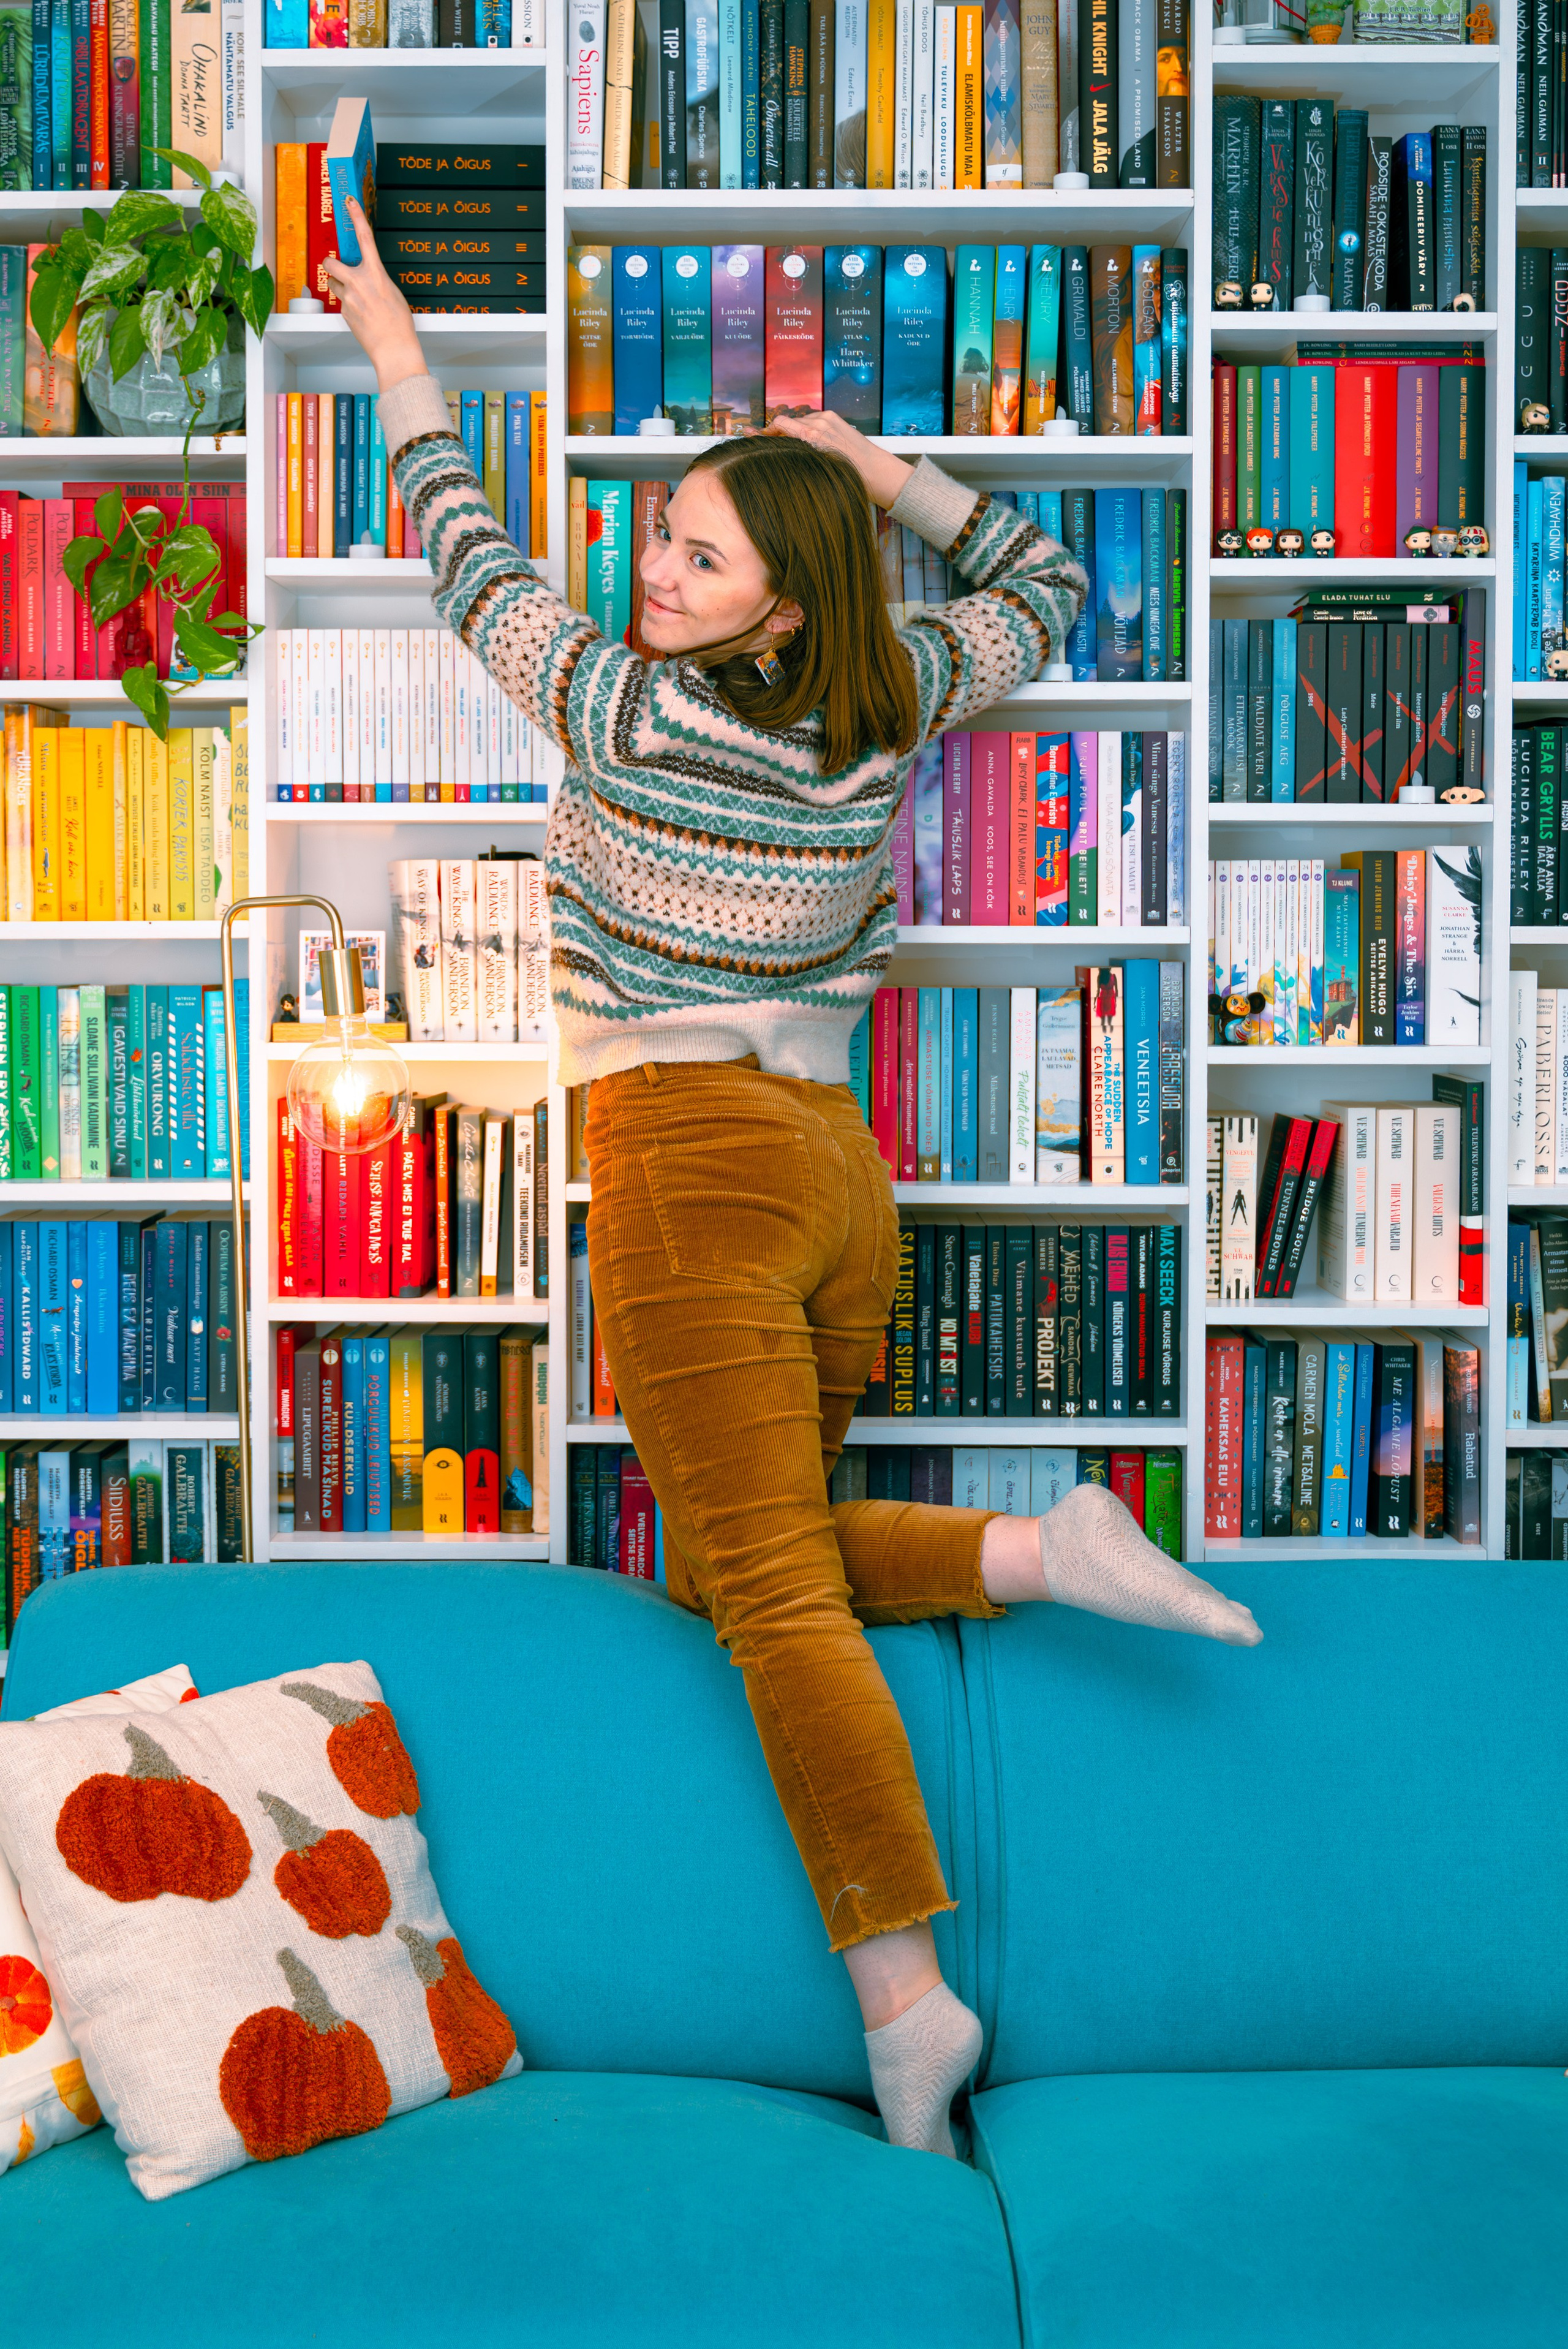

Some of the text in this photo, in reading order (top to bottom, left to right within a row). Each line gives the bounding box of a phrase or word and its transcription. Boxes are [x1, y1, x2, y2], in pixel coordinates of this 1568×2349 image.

[1027, 15, 1052, 25] JOHN
[1028, 26, 1050, 36] GUY
[663, 28, 679, 59] TIPP
[696, 17, 707, 92] GASTROFÜÜSIKA
[1092, 21, 1106, 75] KNIGHT
[572, 48, 599, 134] Sapiens
[746, 93, 755, 157] TÄHELOOD
[1093, 99, 1111, 173] JALA JÄLG
[399, 156, 491, 171] TÕDE JA ÕIGUS
[1379, 151, 1389, 203] ROOSIDE
[398, 200, 491, 215] TÕDE JA ÕIGUS
[398, 240, 489, 255] TÕDE JA ÕIGUS
[399, 272, 491, 286] TÕDE JA ÕIGUS
[836, 307, 870, 316] Lucinda
[842, 317, 864, 328] Riley
[970, 277, 981, 334] HANNAH
[1072, 277, 1085, 340] GRIMALDI
[1108, 276, 1119, 333] MORTON
[832, 358, 874, 368] Whittaker
[840, 348, 864, 358] Harry
[126, 484, 230, 496] MINA OLN SIIN
[598, 490, 620, 594] Marian Keyes
[1150, 499, 1159, 582] FREDRIK BACKMAN
[1548, 491, 1561, 561] WINDHAVEN
[1150, 587, 1159, 651] MEES NIMEGA OVE
[1467, 640, 1482, 694] MAUS
[200, 747, 209, 779] KOLM
[1049, 745, 1058, 790] Bernardine
[1540, 732, 1554, 774] BEAR
[200, 782, 210, 819] NAIST
[952, 809, 962, 895] TÄIUSLIK LAPS
[987, 871, 992, 884] ON
[1403, 855, 1417, 897] Daisy
[87, 1017, 98, 1051] SLOANE
[1094, 1046, 1102, 1089] CLAIRE
[1137, 1038, 1150, 1125] VENEETSIA
[151, 1052, 164, 1137] ORVURONG
[88, 1103, 99, 1149] KADUMINE
[1159, 1260, 1174, 1306] SEECK
[21, 1287, 31, 1379] KALLIS EDWARD
[894, 1232, 913, 1412] SAATUSLIK SUPLUS
[1037, 1318, 1055, 1390] PROJEKT
[1393, 1377, 1402, 1395] ME
[1218, 1397, 1229, 1486] KAHEKSAS ELU
[1300, 1355, 1316, 1506] CARMEN MOLA METSALINE
[1465, 1432, 1474, 1479] Rabatud
